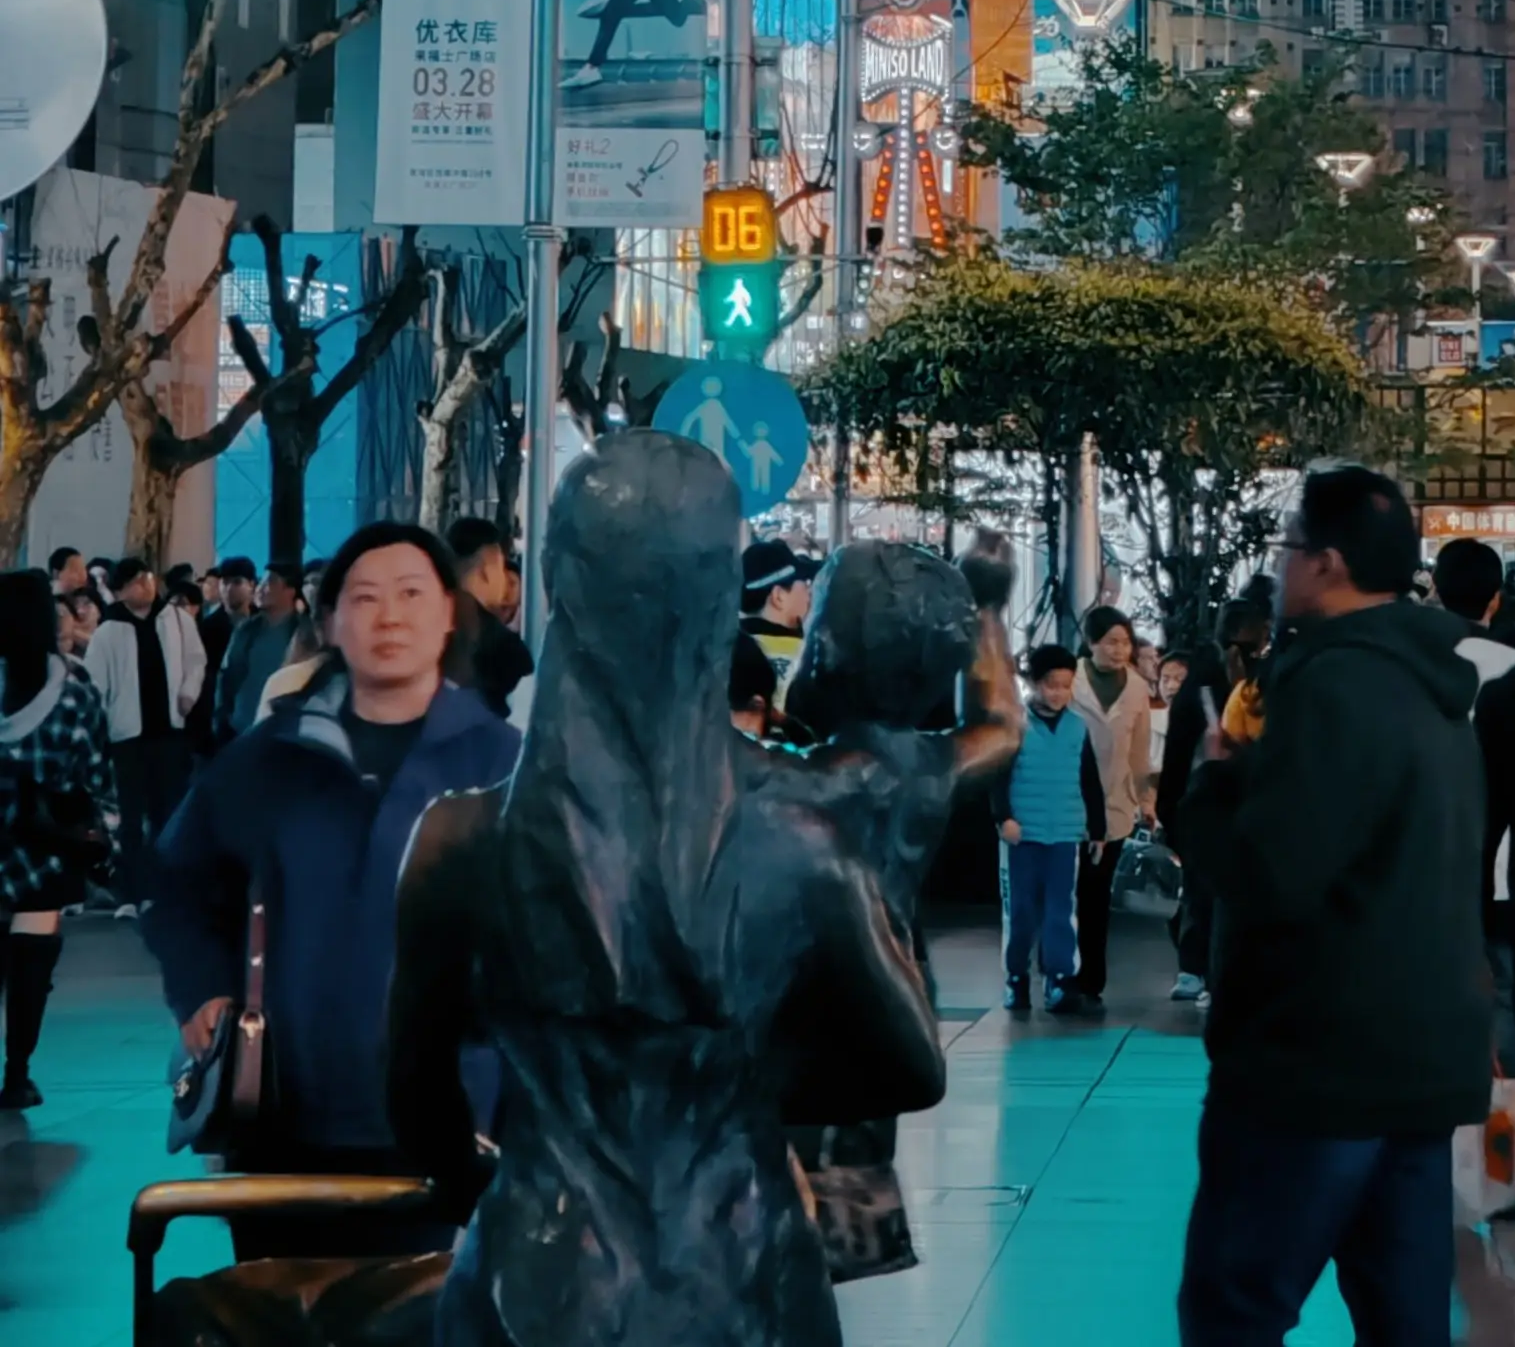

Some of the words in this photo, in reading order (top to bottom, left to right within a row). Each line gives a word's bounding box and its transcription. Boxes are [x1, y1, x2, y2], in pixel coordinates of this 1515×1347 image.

[415, 18, 498, 45] 优衣库
[866, 43, 908, 85] MINISO
[911, 40, 944, 84] LAND
[413, 67, 495, 97] 03.28
[412, 101, 493, 121] 盛大开幕
[567, 138, 611, 155] 好礼2
[711, 205, 763, 251] 06
